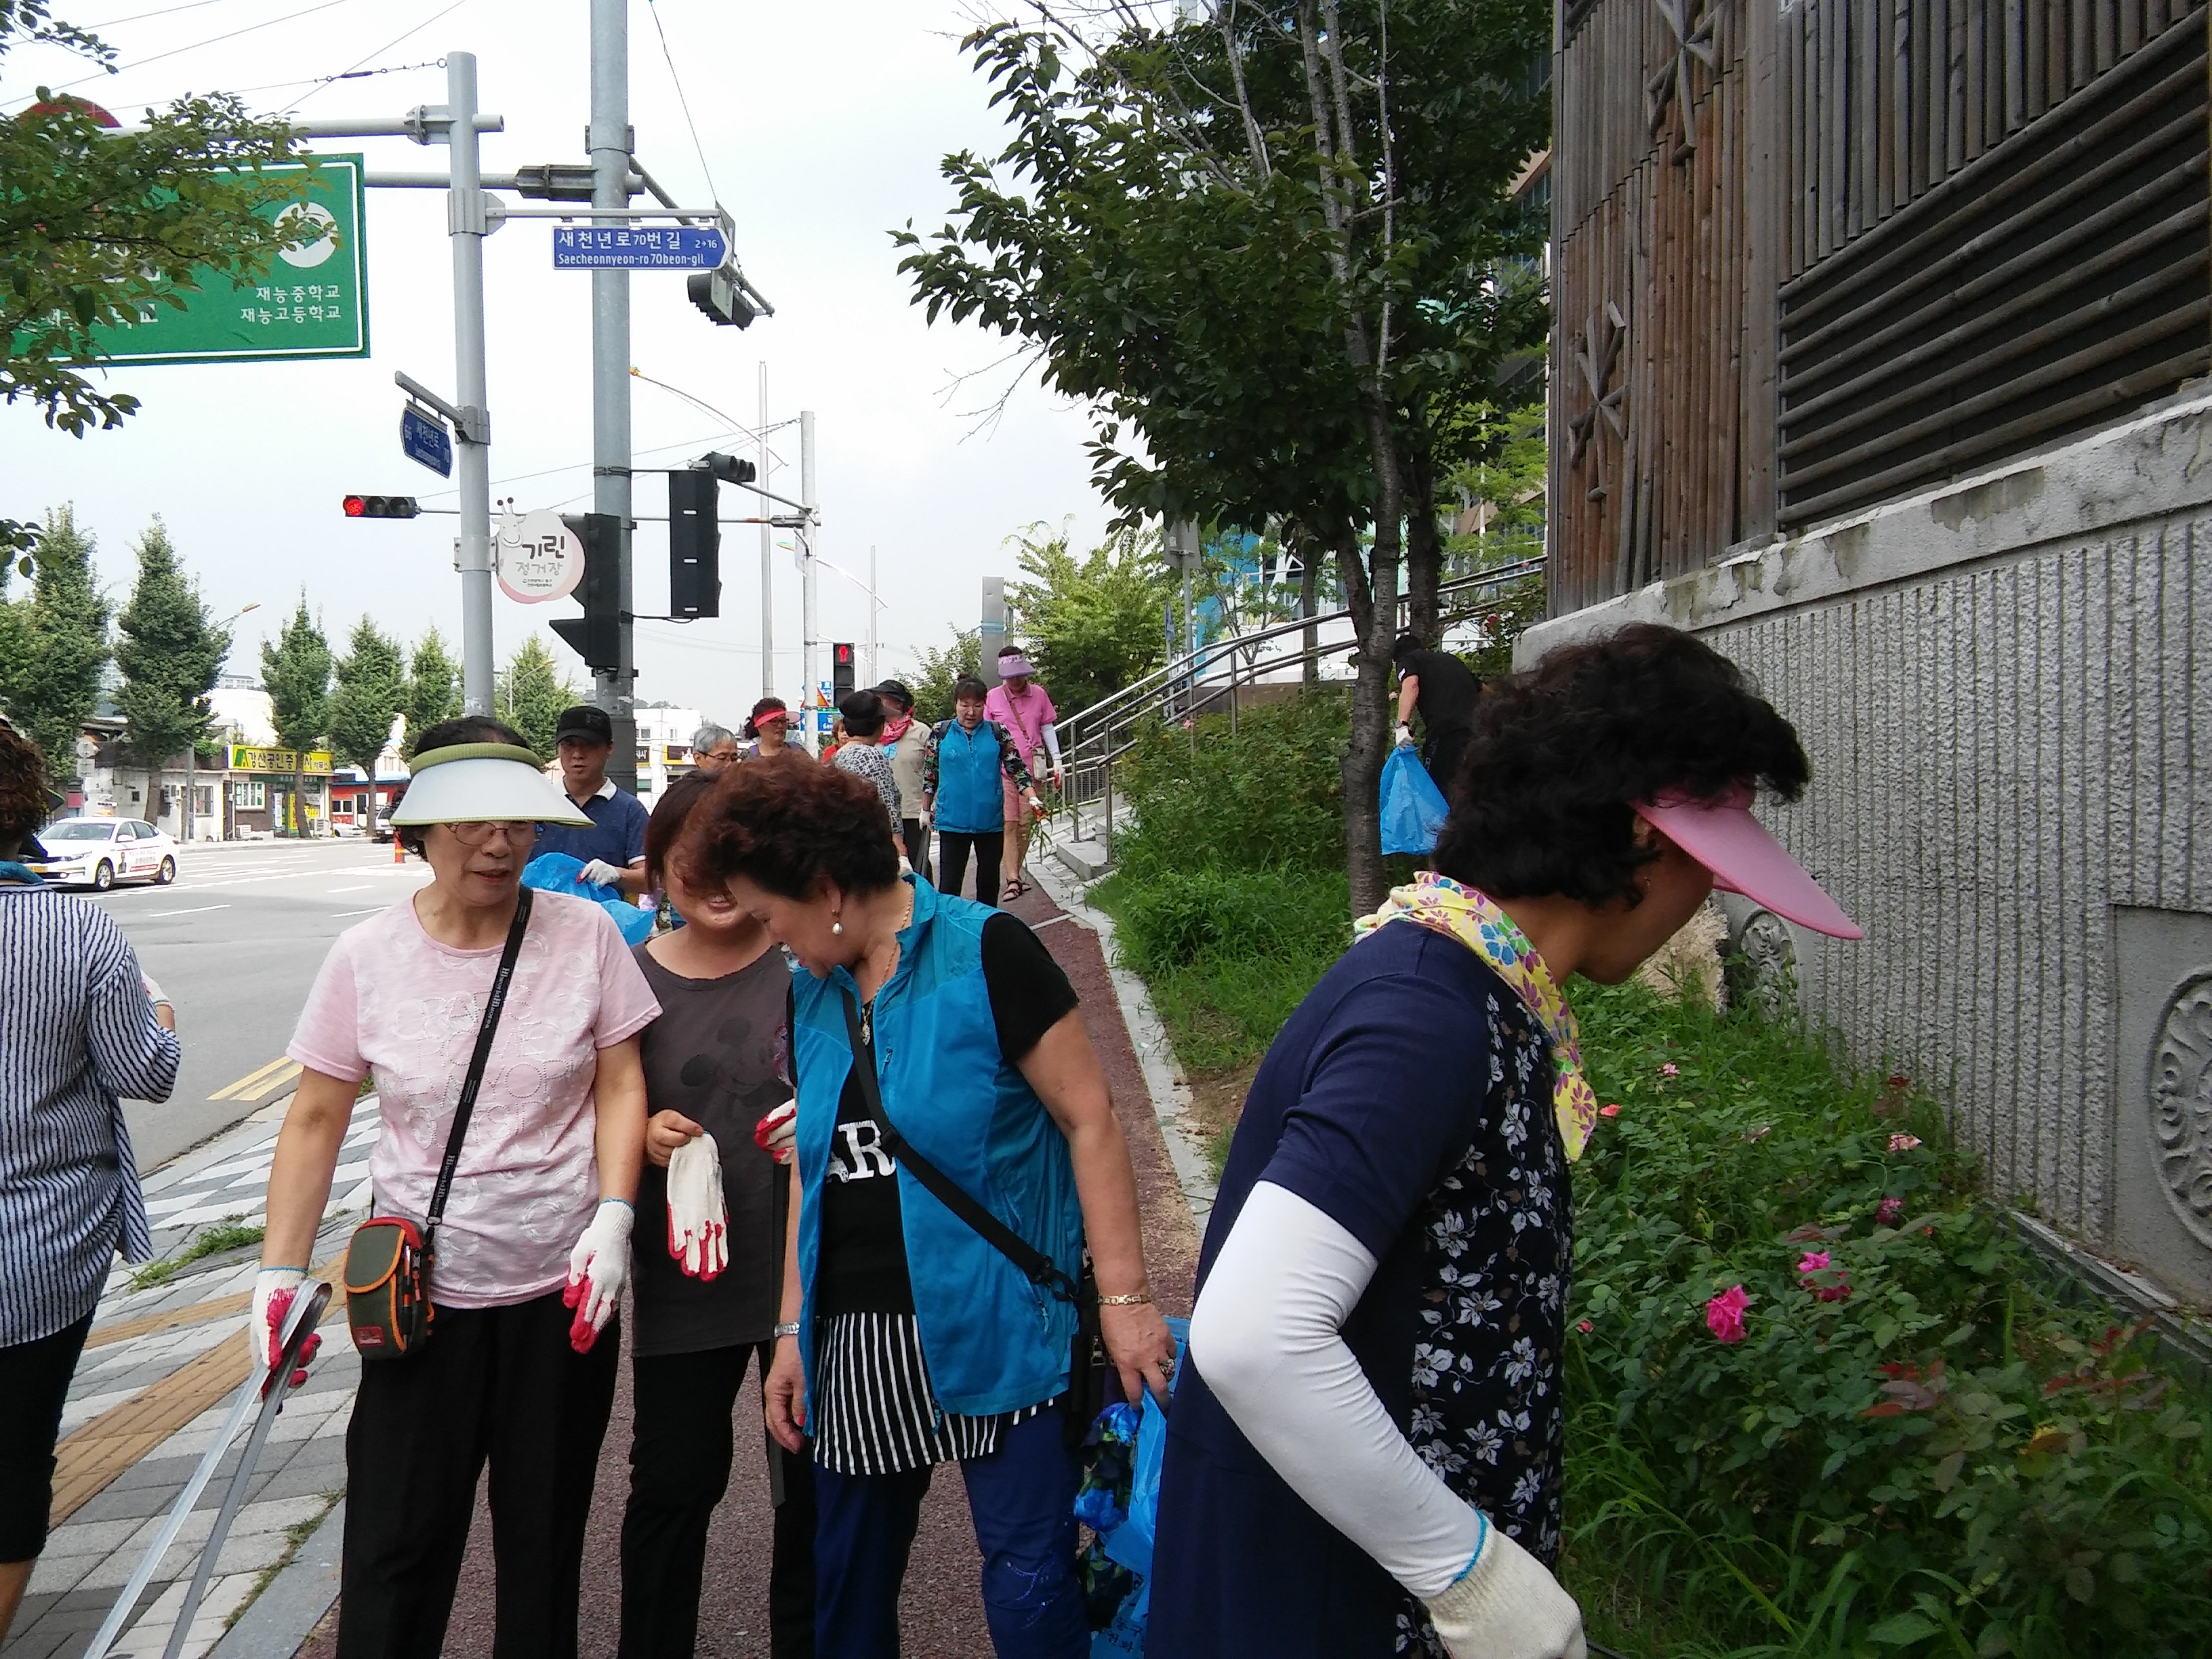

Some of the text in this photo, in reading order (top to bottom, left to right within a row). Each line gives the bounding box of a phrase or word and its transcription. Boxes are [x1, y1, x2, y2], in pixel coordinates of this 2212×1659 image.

[558, 231, 681, 250] 새천년로70번길
[558, 253, 705, 266] Saecheonnyeon-ro 70beon-gil
[255, 285, 341, 304] 재능중학교
[241, 305, 342, 325] 재능고등학교
[522, 535, 565, 560] 기린
[515, 562, 563, 576] 정거장
[248, 752, 312, 770] 강산공인중사
[421, 985, 533, 1030] PAS
[483, 1056, 574, 1099] YOR
